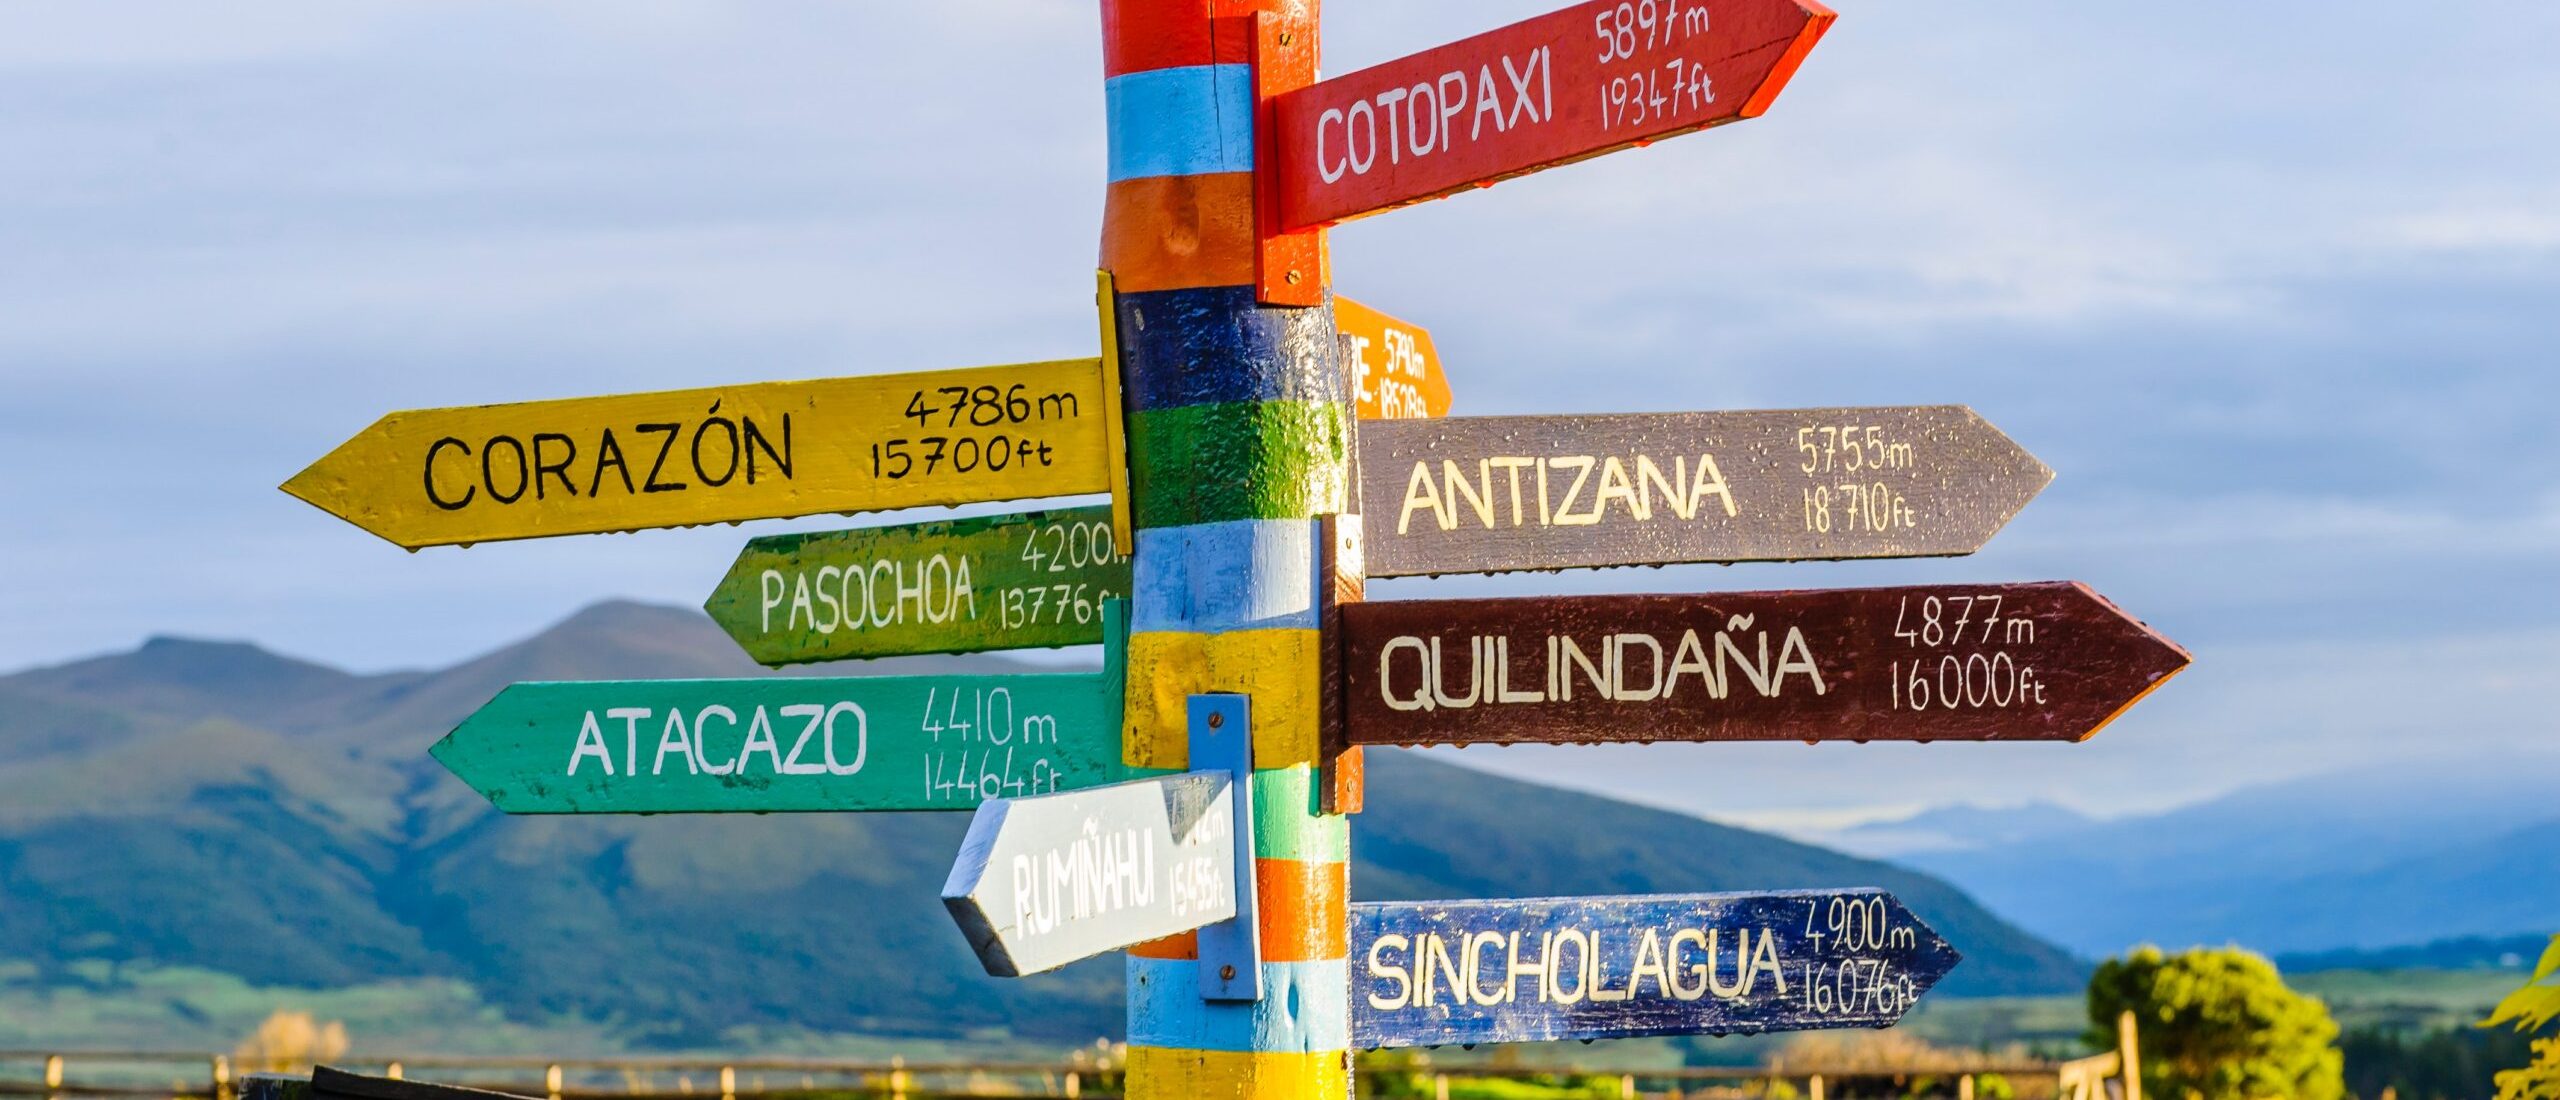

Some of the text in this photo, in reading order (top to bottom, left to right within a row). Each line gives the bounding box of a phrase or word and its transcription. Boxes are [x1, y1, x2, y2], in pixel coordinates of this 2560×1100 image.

[1596, 0, 1709, 63] 5897m
[1317, 45, 1553, 185] COTOPAXI
[1601, 58, 1715, 131] 19347ft
[905, 384, 1078, 428] 4786m
[423, 398, 794, 511] CORAZÓN
[872, 435, 1053, 479] 15700ft
[1799, 426, 1913, 473] 5755m
[1399, 453, 1737, 535] ANTIZANA
[761, 554, 976, 634] PASOCHOA
[1000, 583, 1120, 631] 13776f
[1894, 595, 2034, 648] 4877m
[1380, 612, 1827, 712] QUILINDAÑA
[567, 701, 867, 777] ATACAZO
[1013, 815, 1155, 941] RUMIÑAHUI
[1367, 927, 1788, 1010] SINCHOLAGUA
